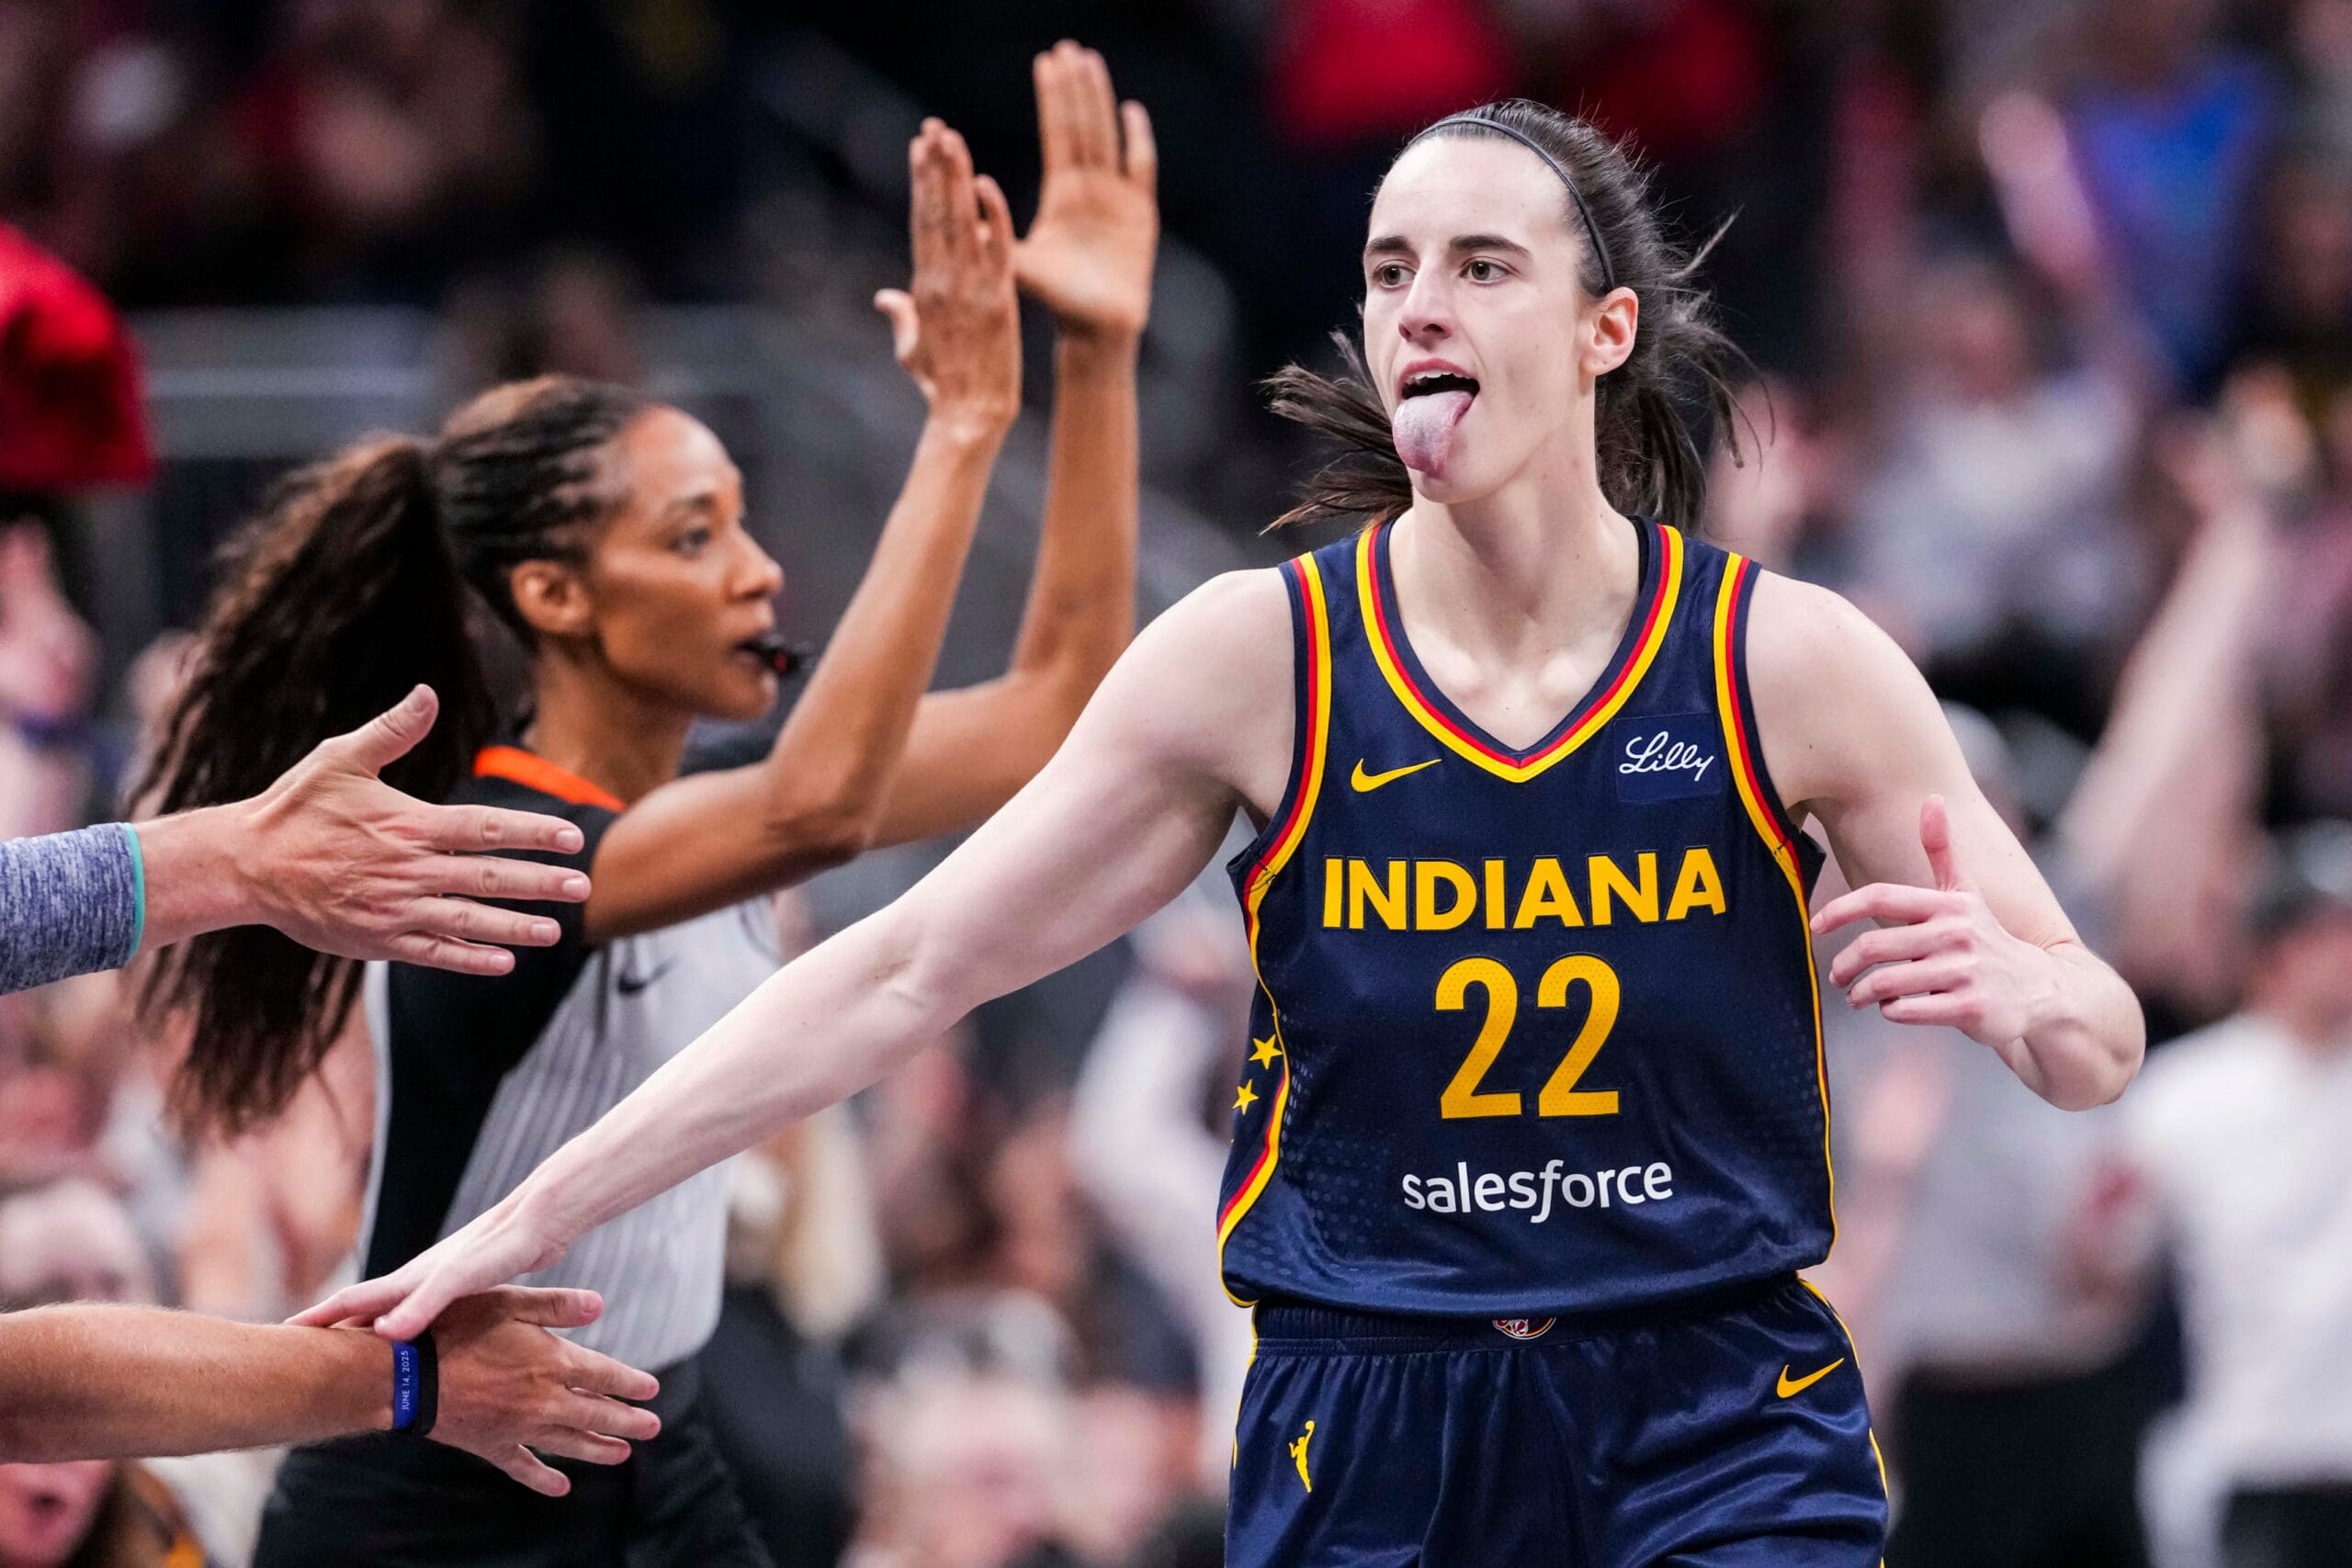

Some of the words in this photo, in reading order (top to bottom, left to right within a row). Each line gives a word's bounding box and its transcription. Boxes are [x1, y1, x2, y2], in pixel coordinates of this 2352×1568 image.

[1619, 731, 1714, 782] Lilly
[1322, 847, 1727, 931] INDIANA
[1434, 955, 1622, 1120] 22
[1402, 1159, 1673, 1223] salesforce
[401, 1350, 410, 1373] 2025
[401, 1390, 410, 1411] JUNE
